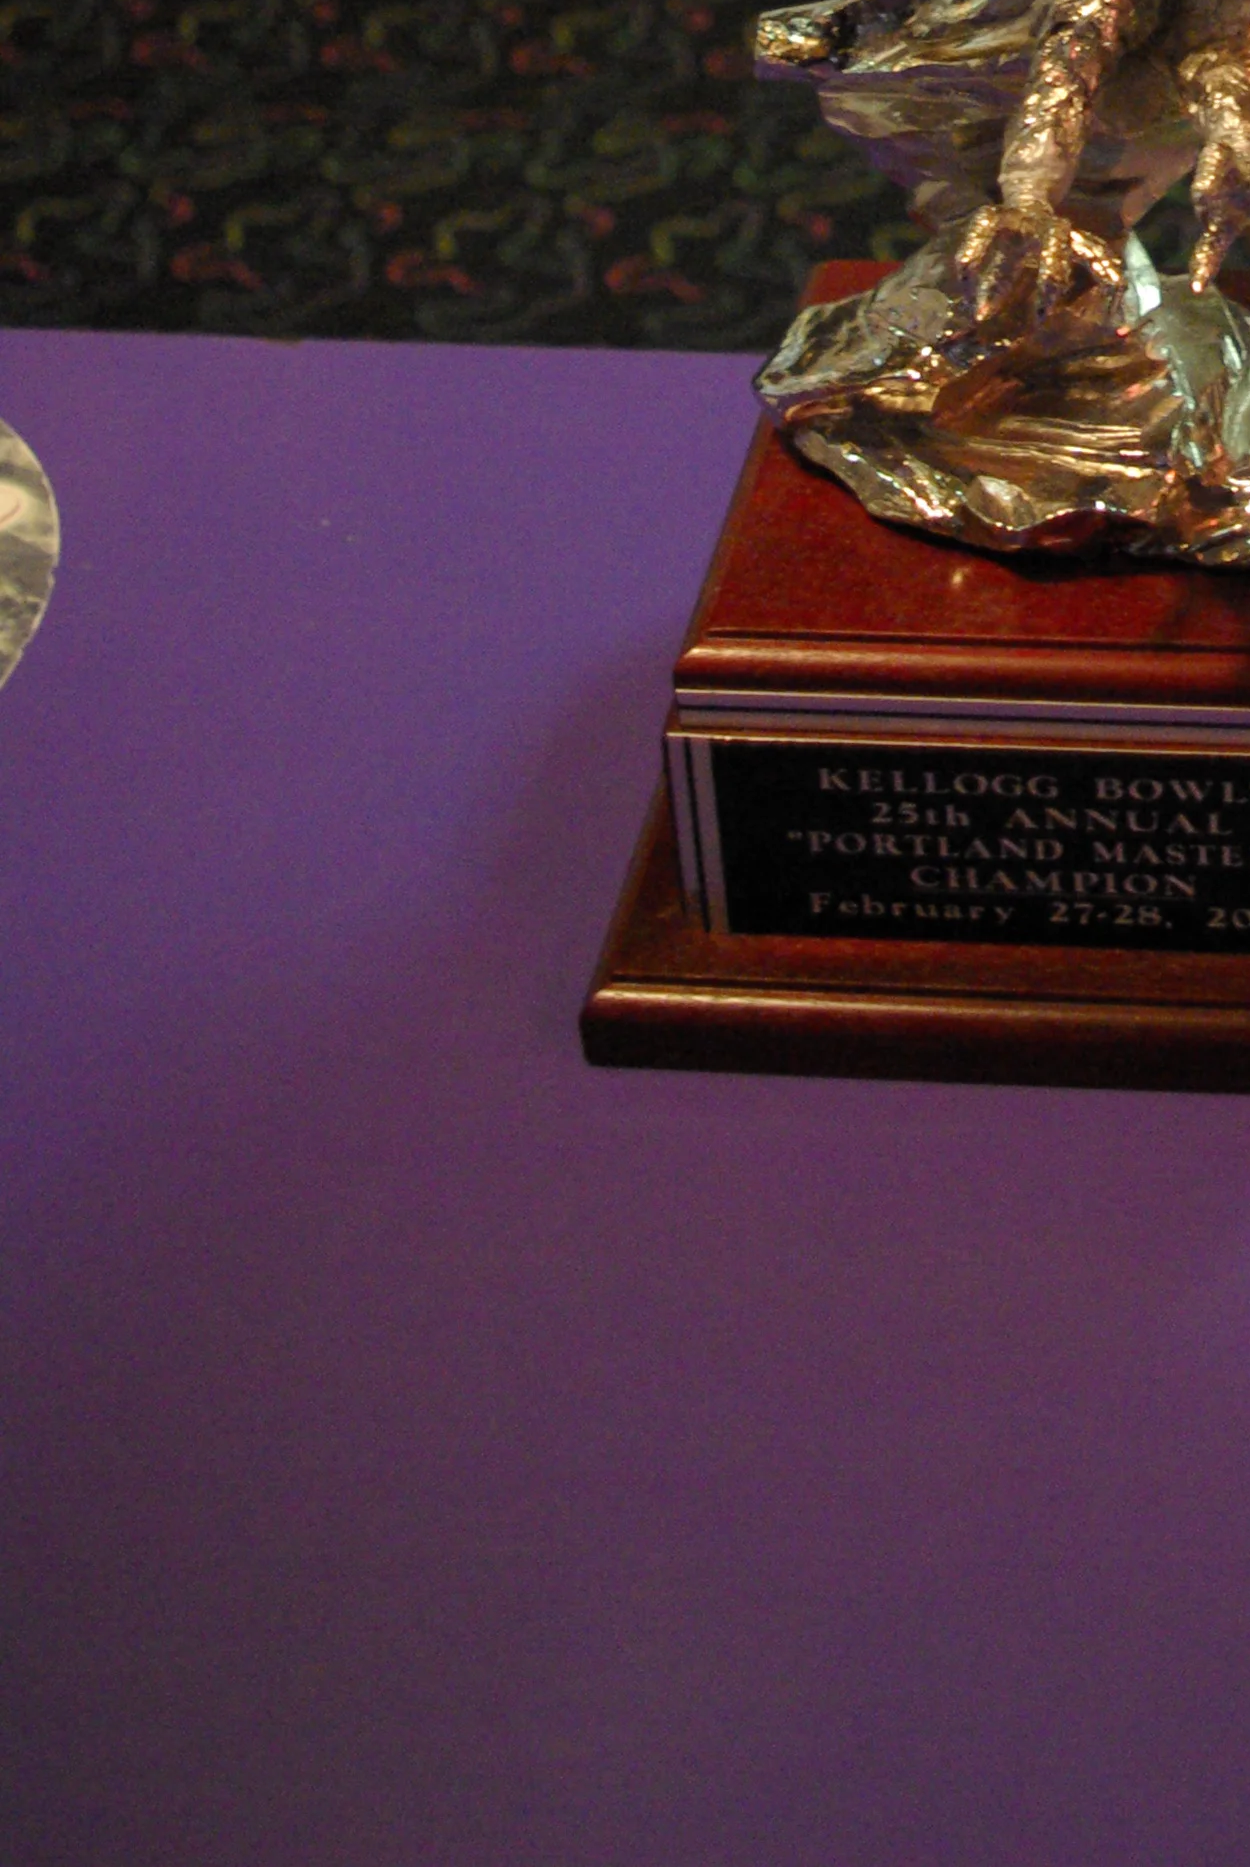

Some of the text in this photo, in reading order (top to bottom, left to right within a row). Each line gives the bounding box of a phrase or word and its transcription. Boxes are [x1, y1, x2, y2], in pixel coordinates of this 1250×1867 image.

[818, 767, 1060, 800] KELLOGG
[869, 801, 1234, 836] 25th ANNUAL
[786, 829, 1066, 863] "PORTLAND
[909, 864, 1197, 898] CHAMPION
[807, 891, 1016, 925] February
